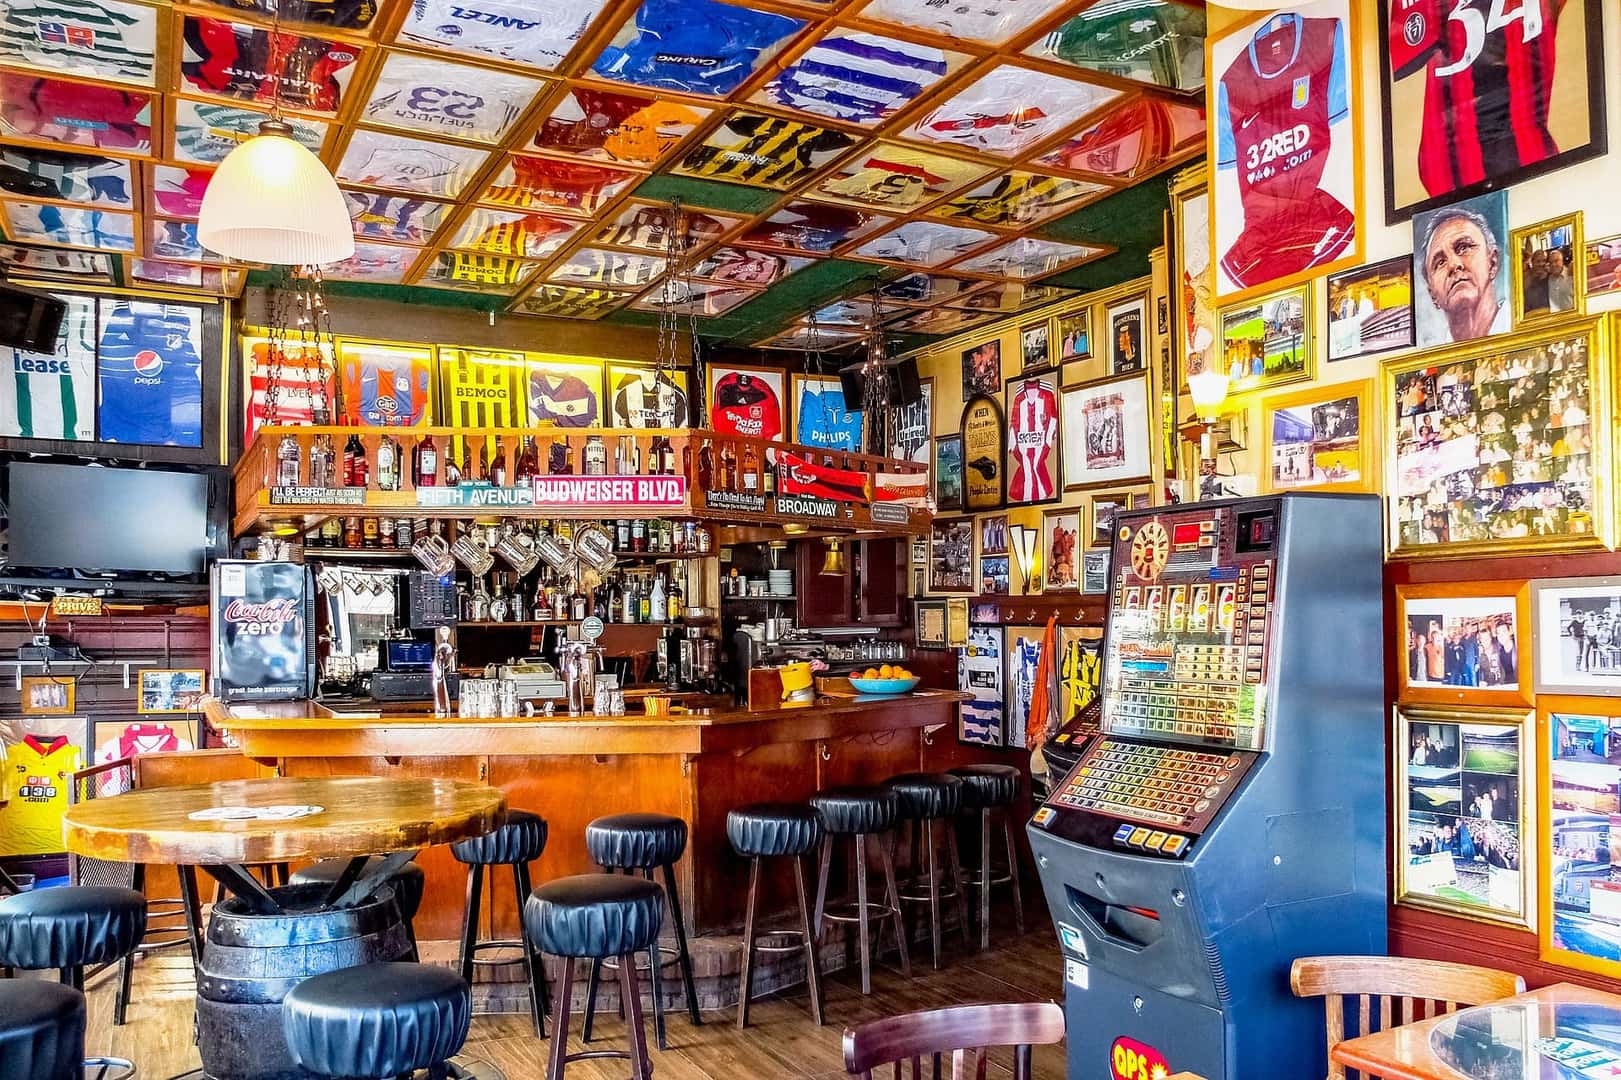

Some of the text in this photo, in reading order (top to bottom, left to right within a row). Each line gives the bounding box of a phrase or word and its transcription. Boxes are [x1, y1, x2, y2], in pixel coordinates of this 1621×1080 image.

[450, 6, 541, 30] ANCEL
[657, 55, 718, 66] CARLING
[407, 87, 485, 119] 23
[1247, 124, 1311, 170] 32RED
[134, 377, 161, 386] pepsi
[456, 387, 507, 399] BEMOG
[272, 487, 284, 496] I'LL
[285, 487, 295, 496] BE
[295, 487, 327, 497] PERFECT
[472, 489, 528, 505] AVENUE
[536, 480, 684, 502] BUDWEISER BLVD.
[778, 499, 837, 517] BROADWAY
[224, 598, 301, 623] Coca-Cola
[236, 622, 283, 635] zero
[19, 785, 57, 798] 138
[1113, 1044, 1149, 1080] QPS
